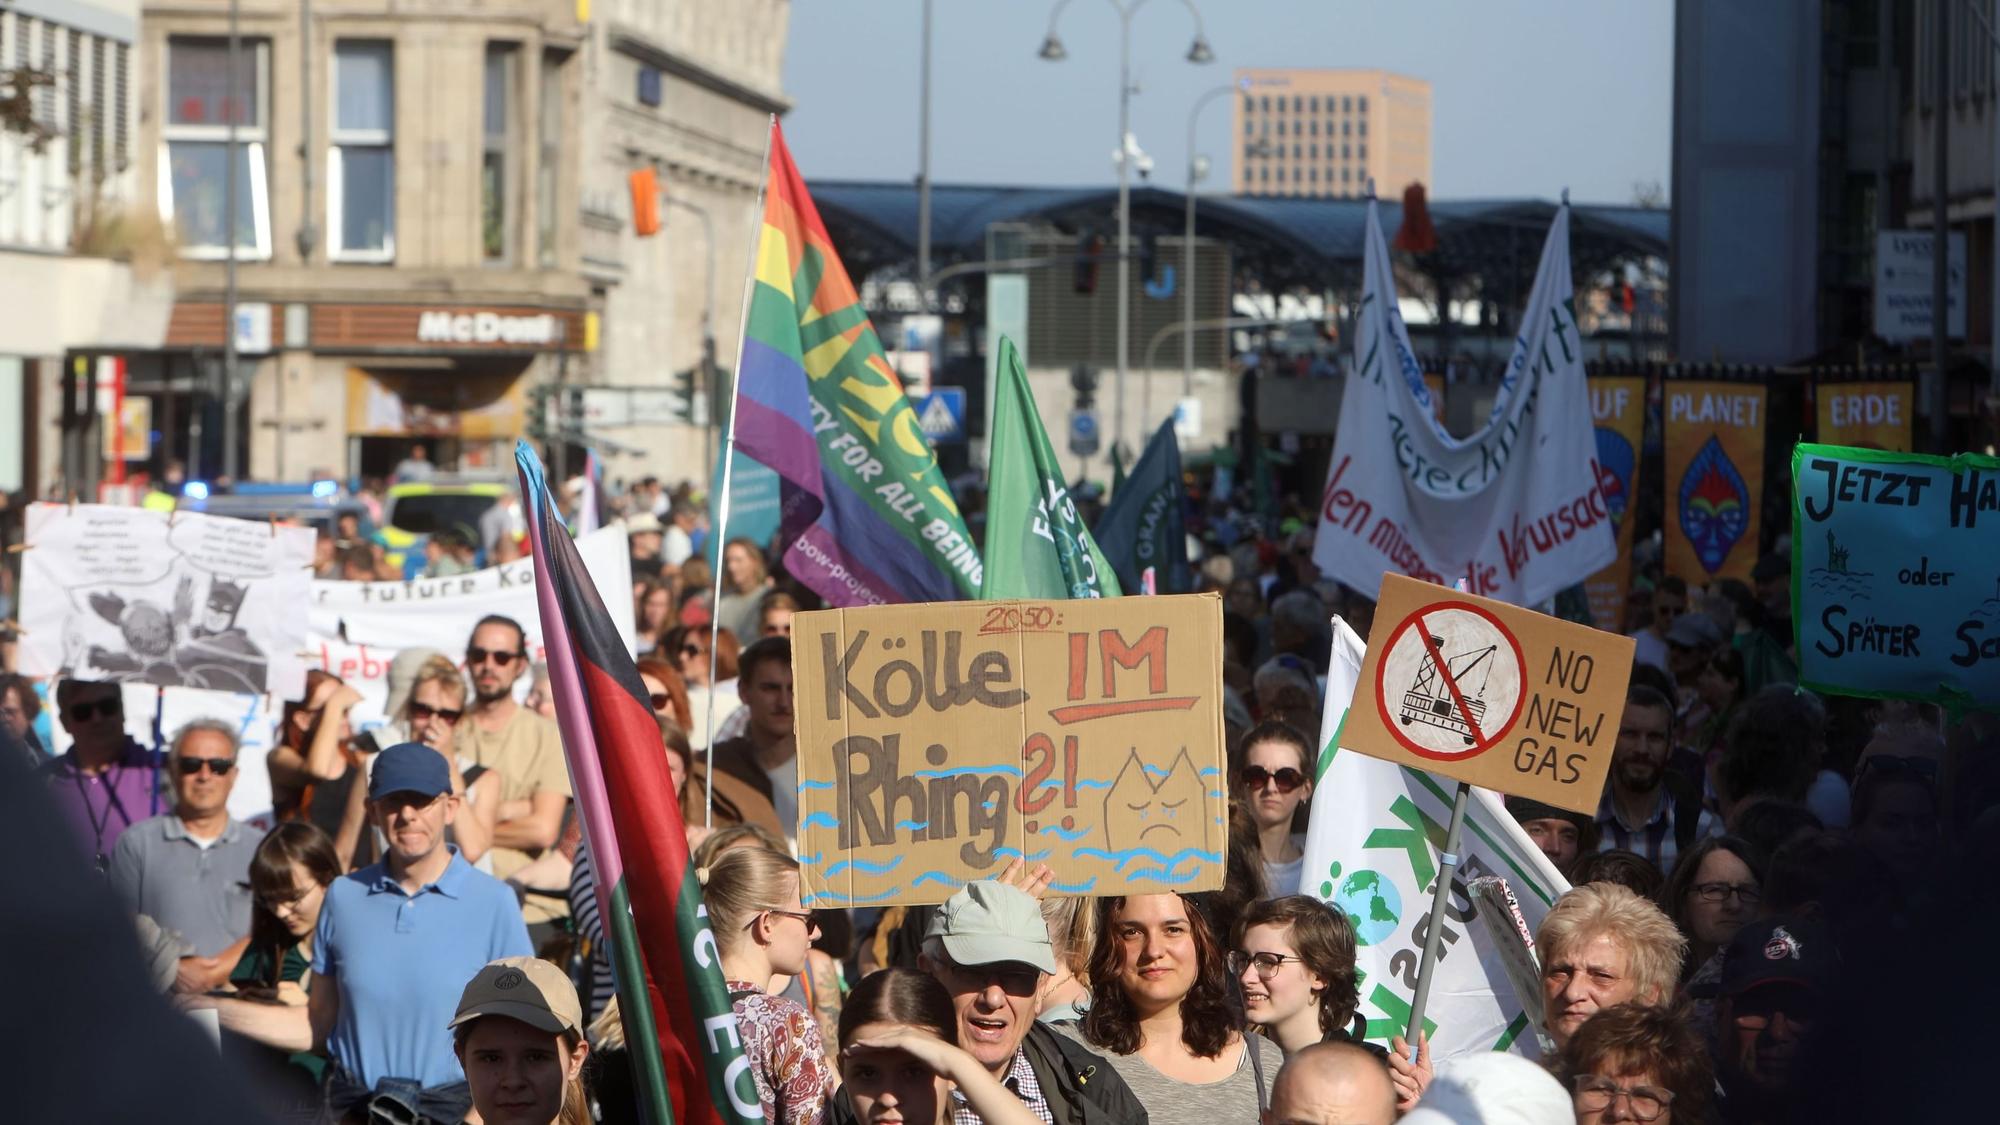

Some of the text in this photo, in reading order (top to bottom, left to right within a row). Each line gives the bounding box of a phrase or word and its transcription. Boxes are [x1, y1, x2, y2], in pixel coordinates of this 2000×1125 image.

[1670, 393, 1760, 427] PLANET
[1830, 393, 1900, 426] ERDE
[829, 432, 883, 483] FOR
[875, 482, 925, 523] ALL
[1804, 459, 2000, 528] JETZT HA
[1898, 556, 1955, 586] oder
[1815, 604, 2000, 667] SPÄTER SC
[820, 626, 1168, 721] Kölle IM
[1545, 646, 1594, 695] NO
[1525, 692, 1605, 747] NEW
[1513, 737, 1588, 784] GAS
